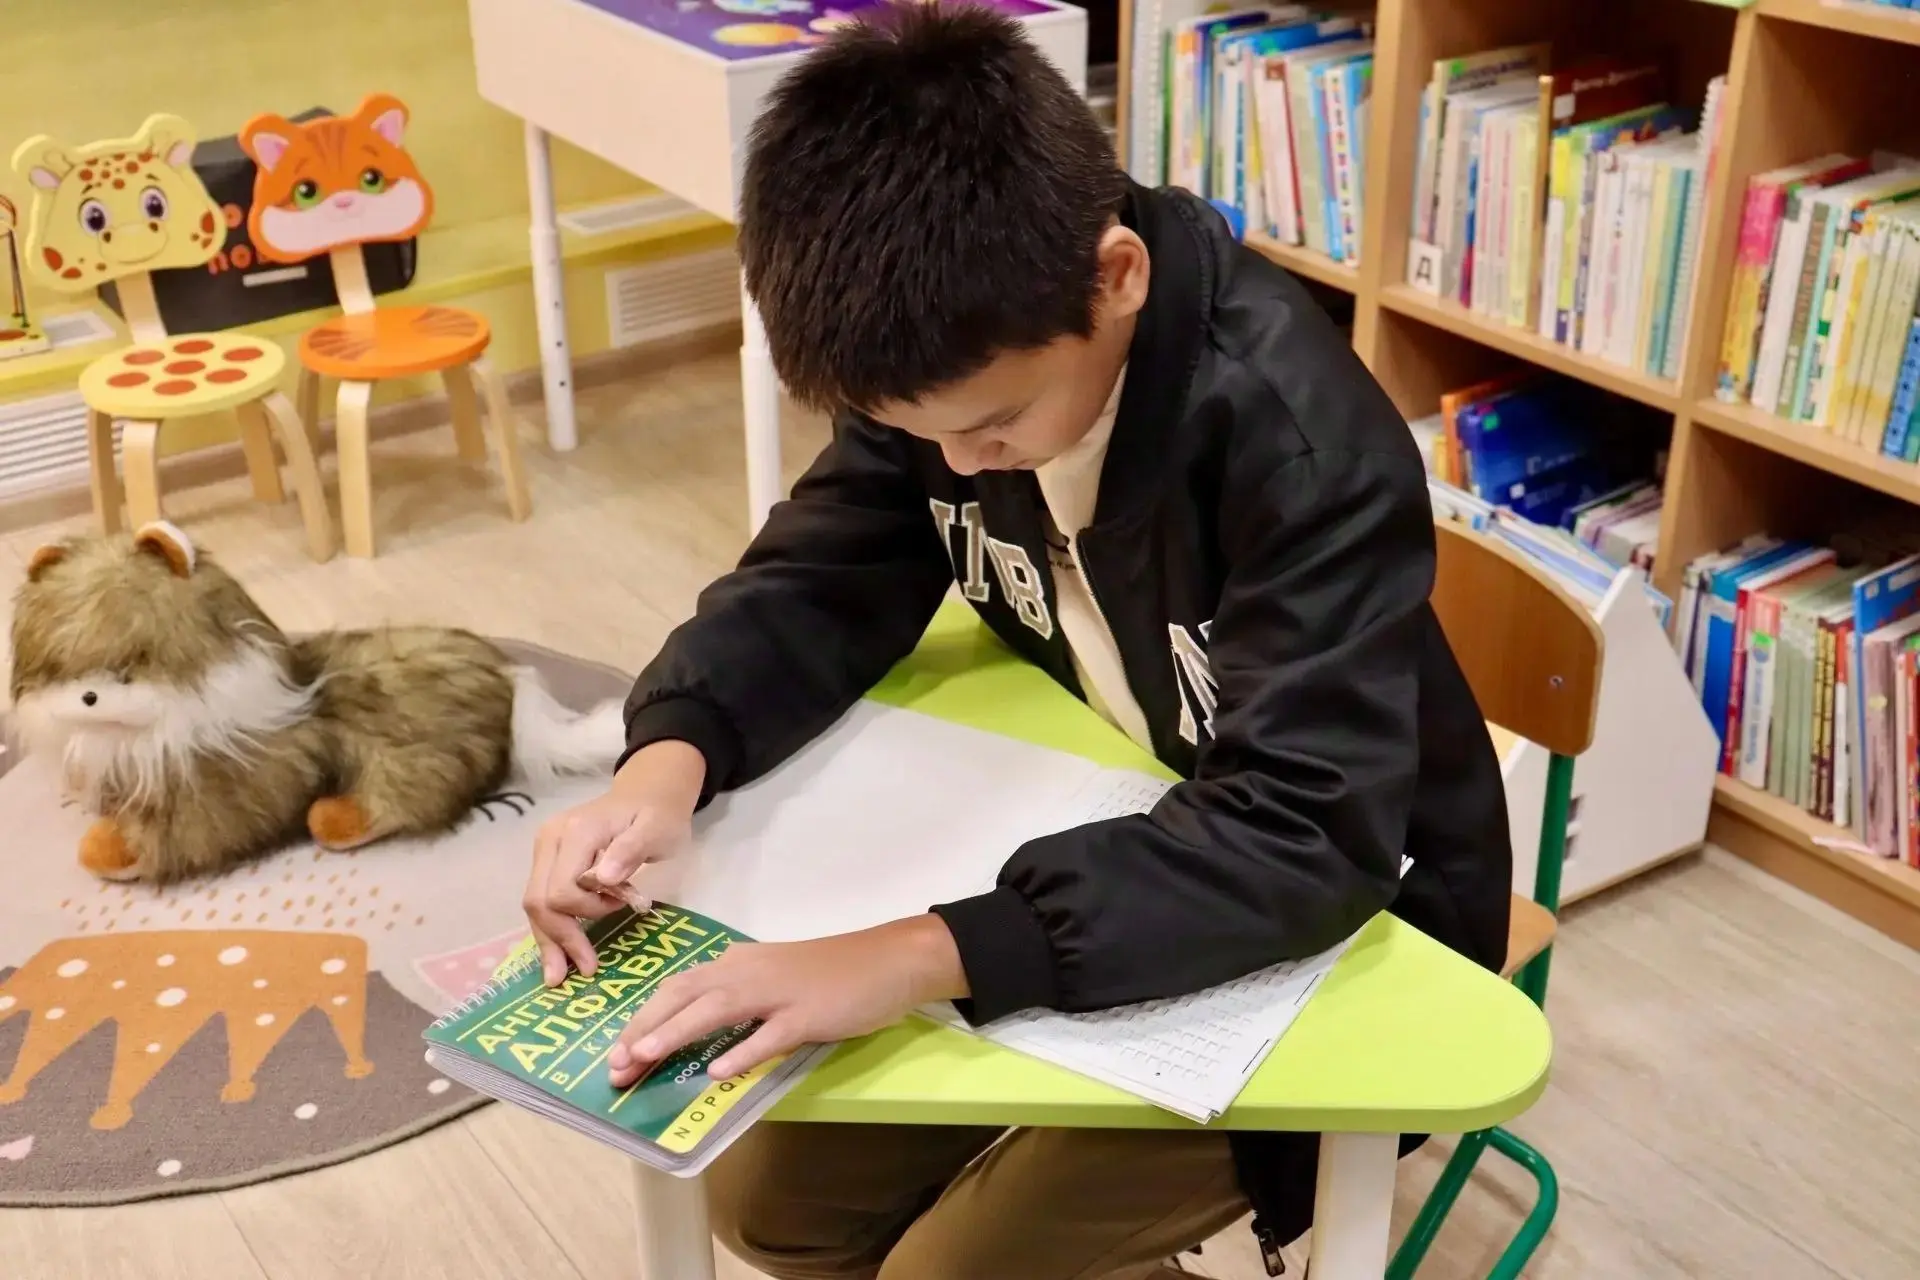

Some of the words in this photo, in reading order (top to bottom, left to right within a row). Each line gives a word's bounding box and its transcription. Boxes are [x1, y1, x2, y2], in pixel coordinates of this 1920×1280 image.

[509, 916, 708, 1073] АЛФАВИТ
[550, 1071, 570, 1085] В
[674, 1060, 701, 1085] ООО
